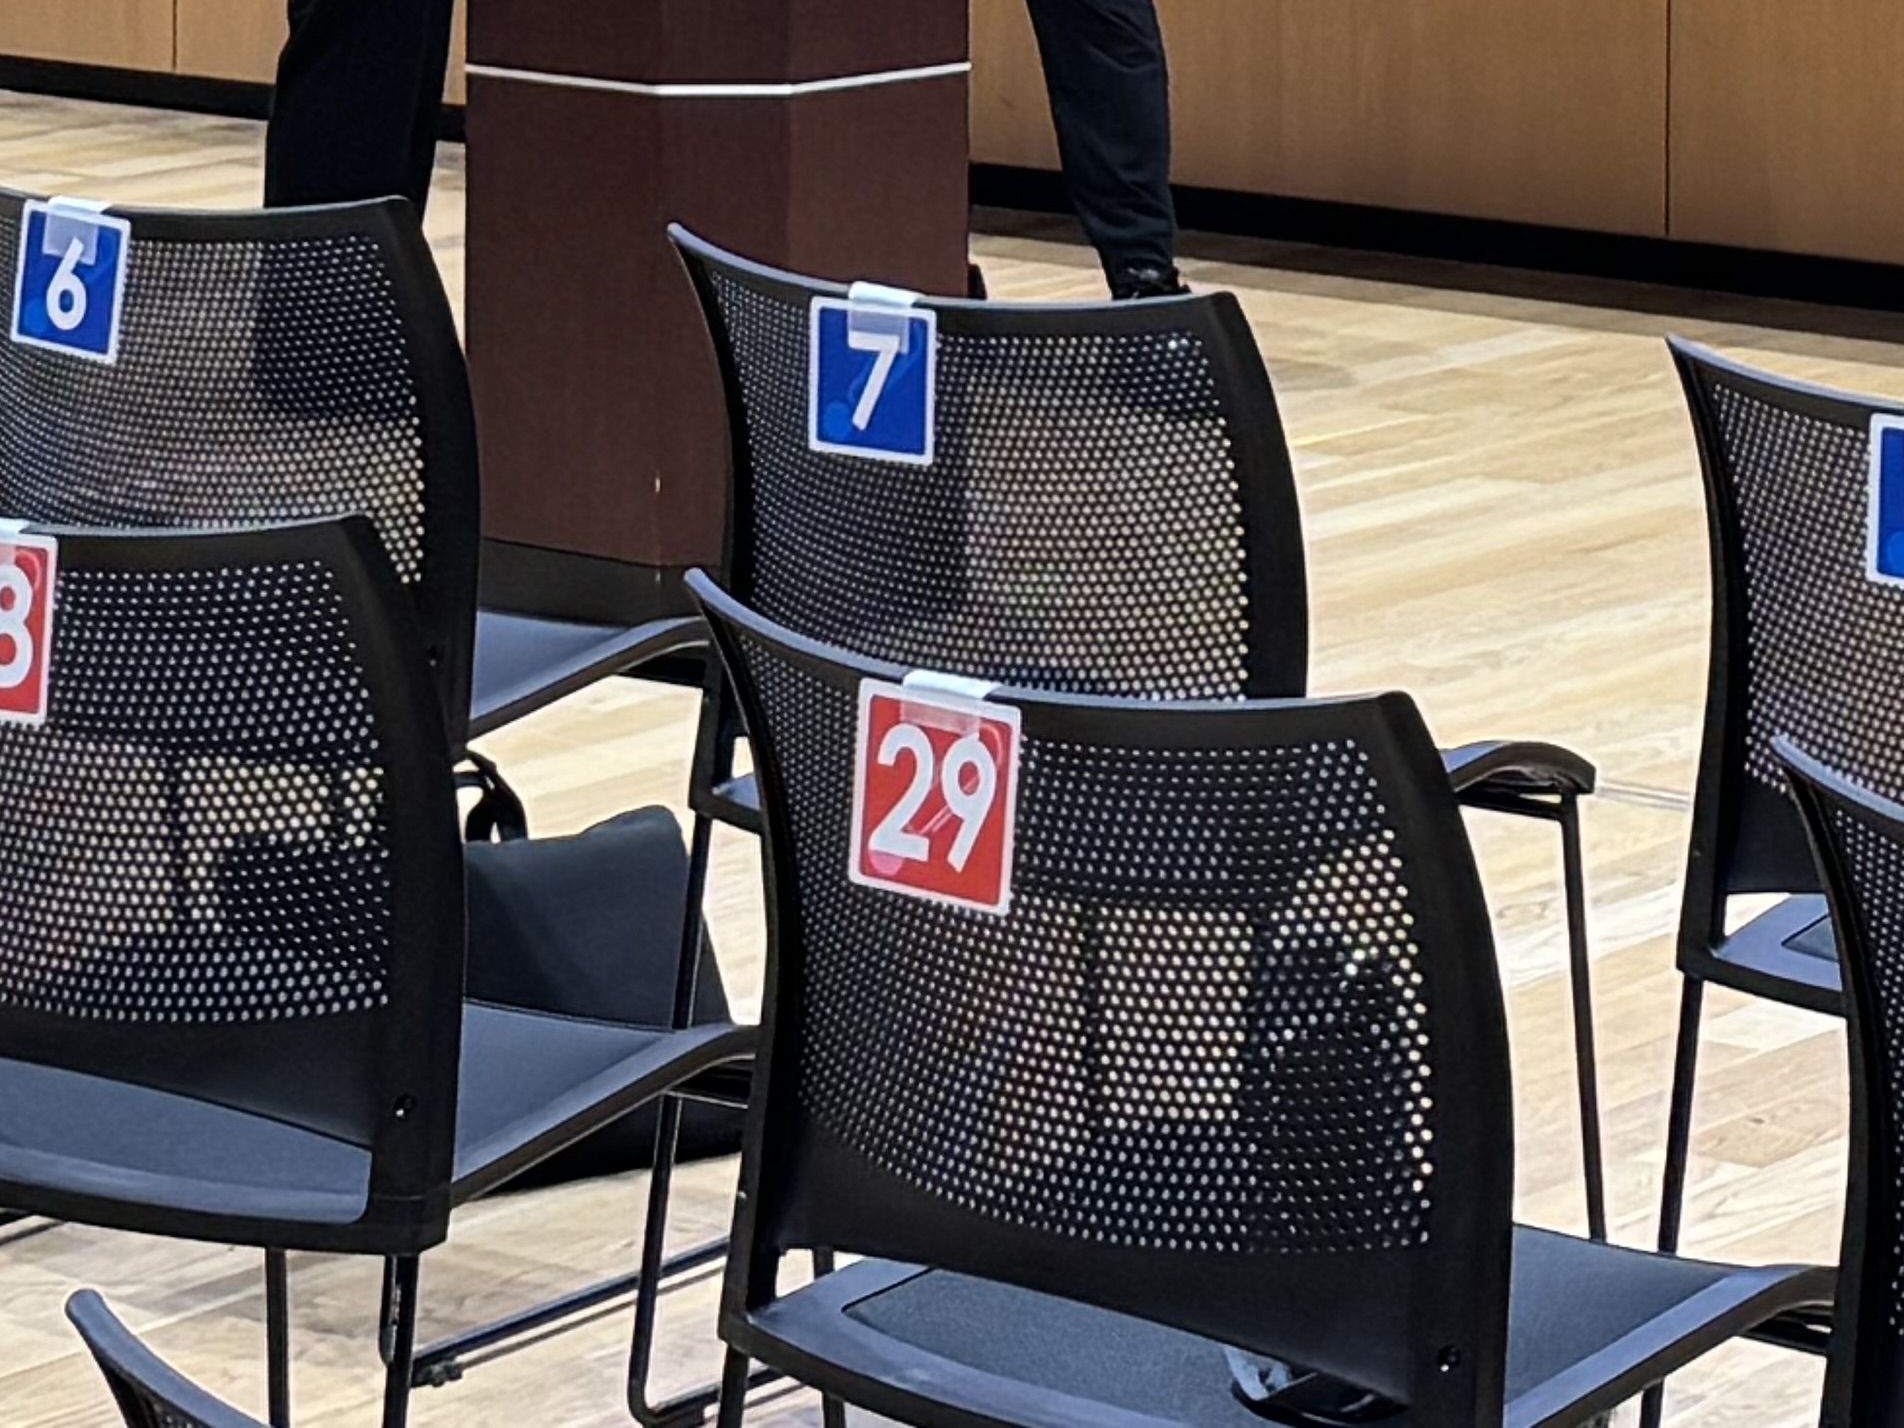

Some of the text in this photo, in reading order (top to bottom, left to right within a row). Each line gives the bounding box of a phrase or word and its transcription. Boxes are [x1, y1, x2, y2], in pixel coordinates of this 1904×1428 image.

[43, 240, 86, 332] 6
[848, 330, 902, 432] 7
[874, 722, 997, 876] 29
